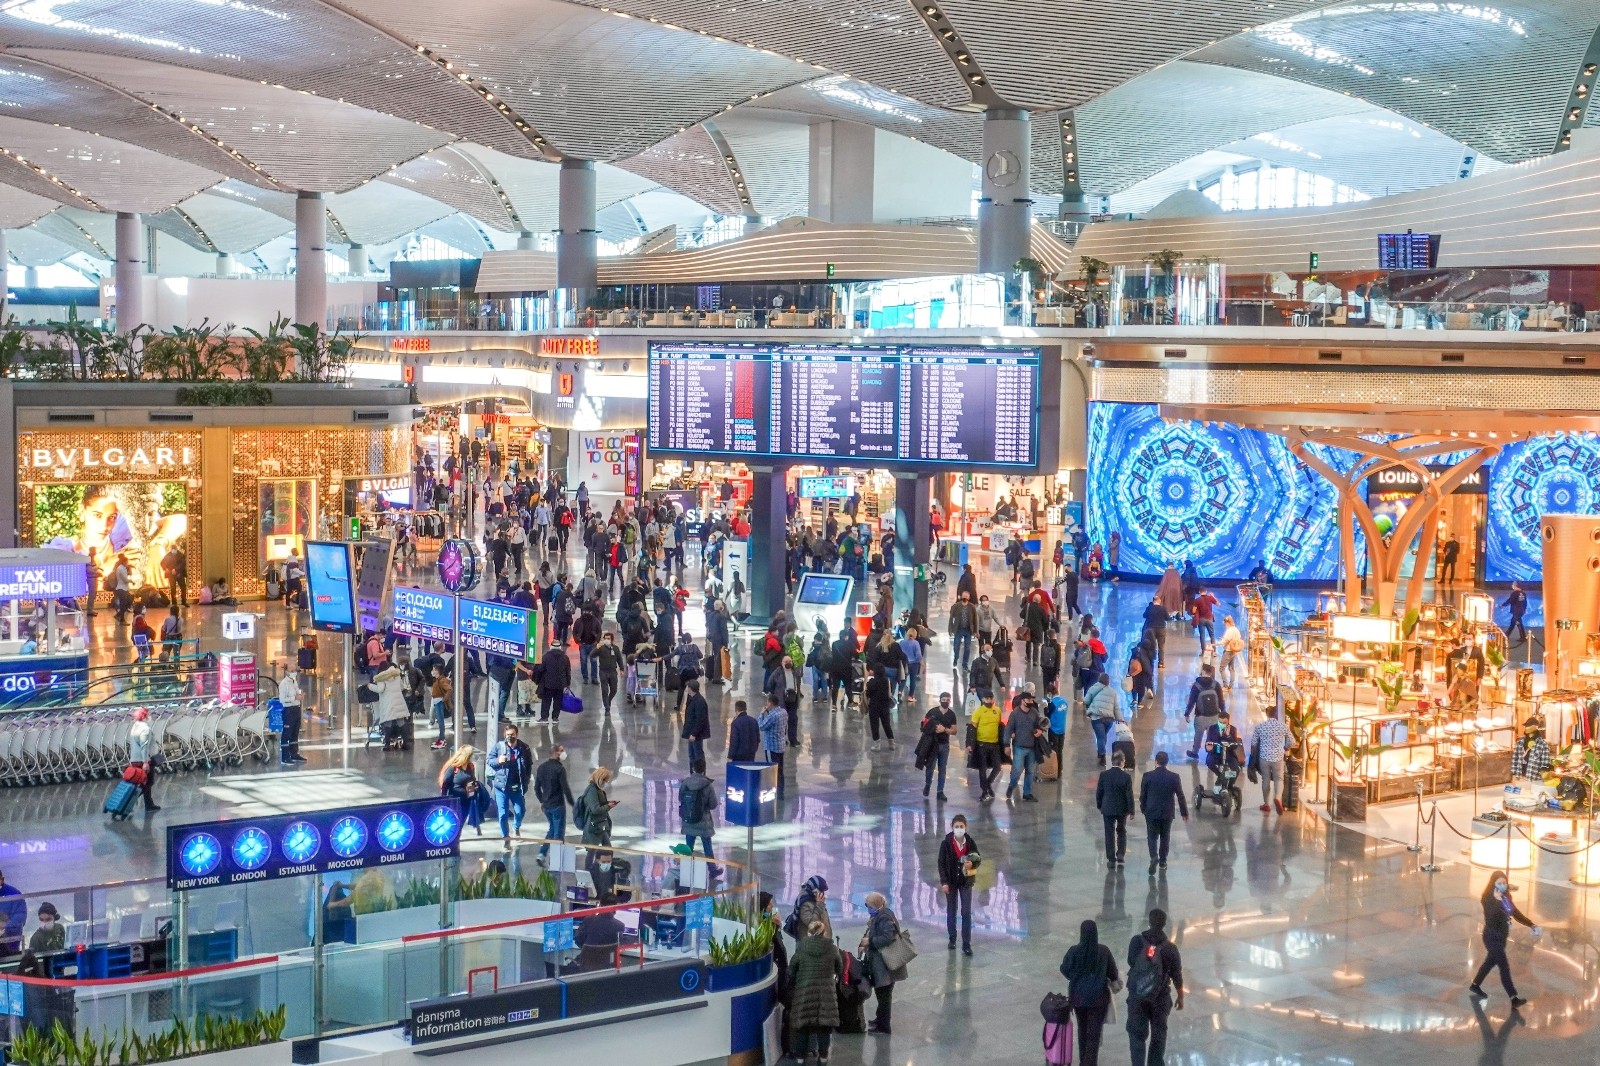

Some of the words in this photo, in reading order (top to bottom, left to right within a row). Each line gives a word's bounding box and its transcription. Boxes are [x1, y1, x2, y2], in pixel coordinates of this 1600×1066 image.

[393, 339, 409, 350] DUTY
[410, 339, 430, 351] FREE
[541, 338, 566, 354] DUTY
[568, 338, 598, 354] FREE
[32, 447, 192, 467] BVLGARI
[587, 451, 601, 463] TO
[1379, 471, 1419, 484] LOUIS
[1010, 488, 1030, 497] SALE
[14, 570, 46, 582] TAX
[0, 582, 62, 595] REFUND
[406, 593, 443, 610] C1,C2,C3,C4
[406, 607, 417, 618] A-B
[473, 605, 512, 623] E1,E2,E3,E4
[472, 619, 478, 630] D
[380, 853, 405, 863] DUBAI
[426, 847, 451, 857] TOKYO
[279, 864, 317, 875] ISTANBUL
[328, 858, 364, 869] MOSCOW
[232, 870, 266, 881] LONDON
[177, 879, 194, 888] NEW
[195, 876, 220, 886] YORK
[417, 1009, 460, 1023] danışma
[484, 1015, 506, 1026] 咨询台
[416, 1018, 482, 1037] information
